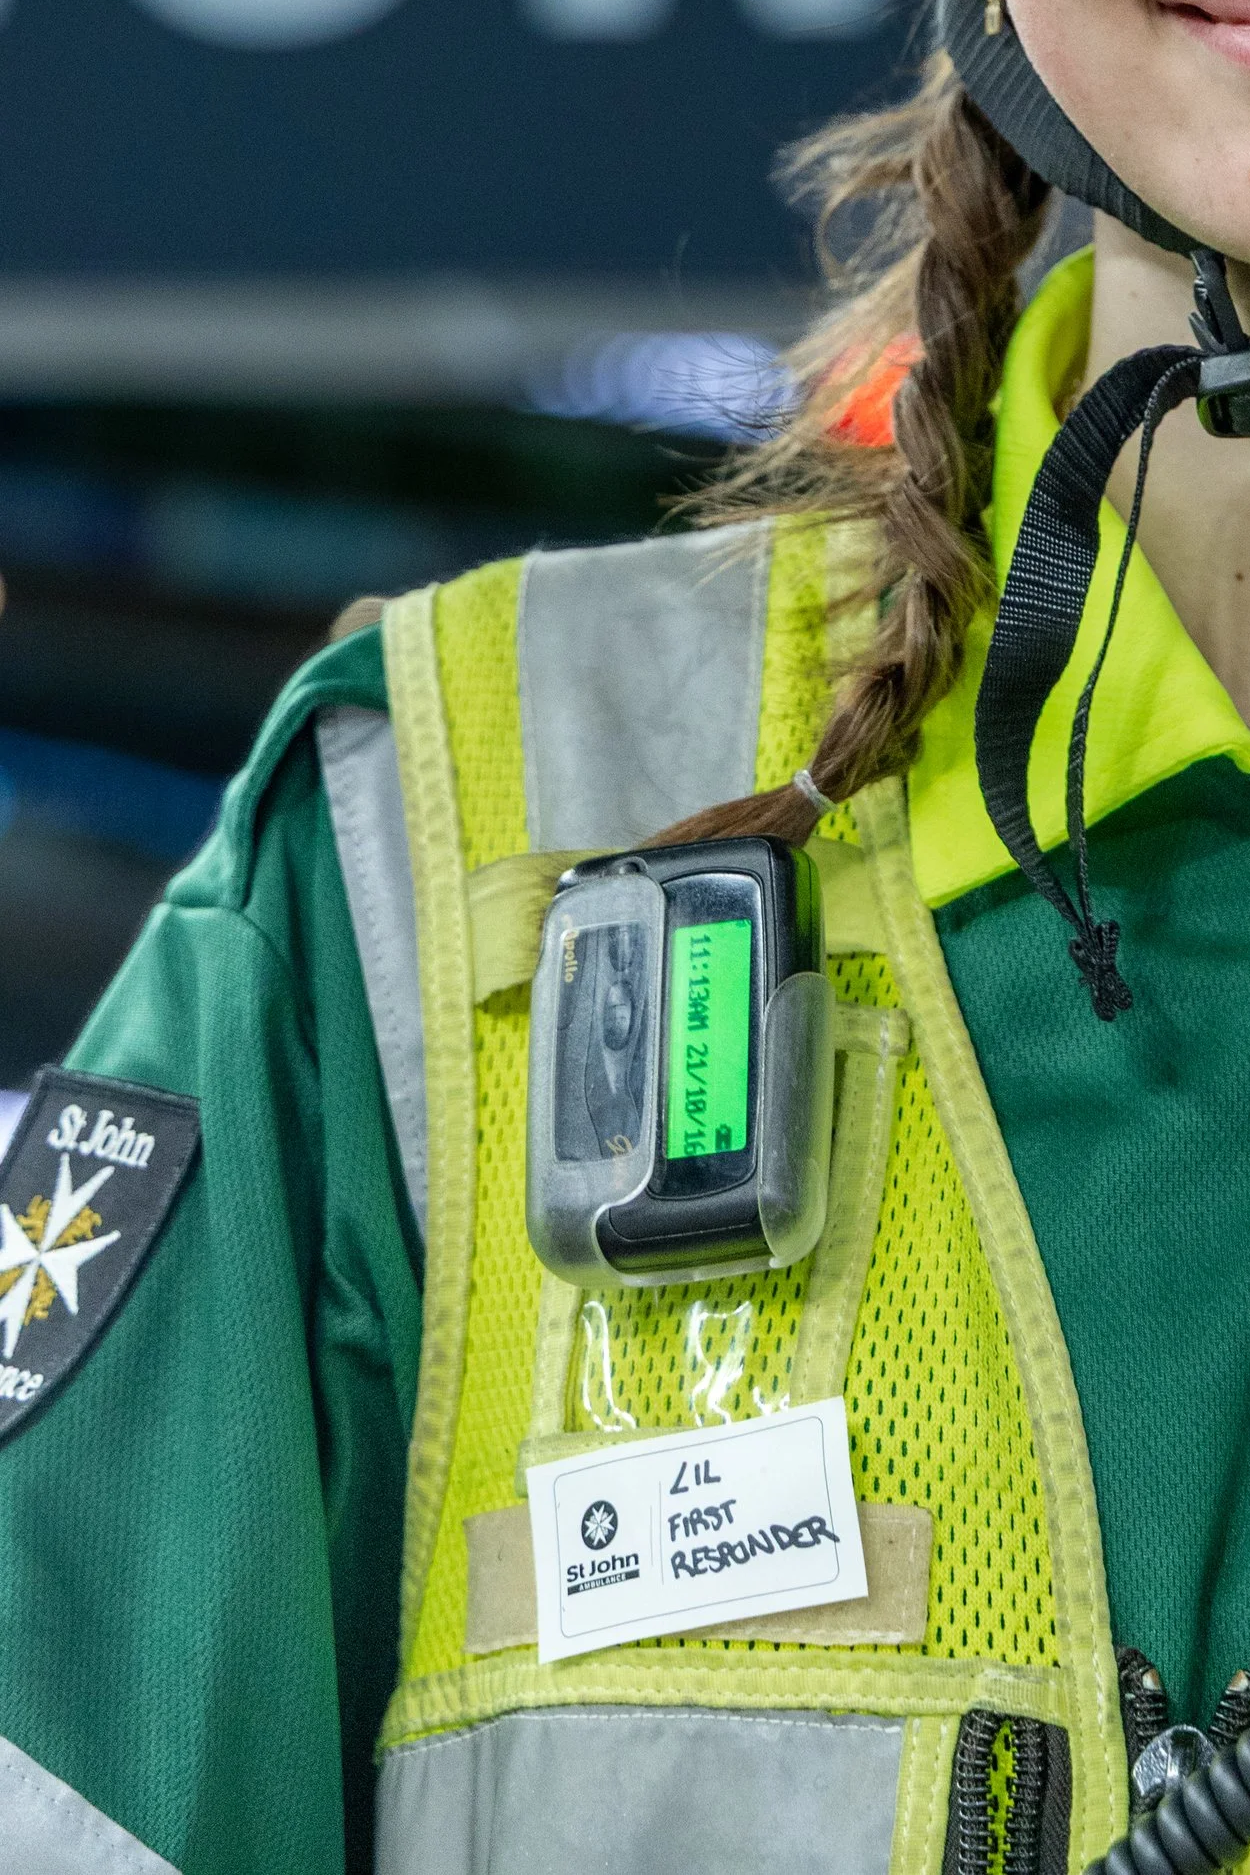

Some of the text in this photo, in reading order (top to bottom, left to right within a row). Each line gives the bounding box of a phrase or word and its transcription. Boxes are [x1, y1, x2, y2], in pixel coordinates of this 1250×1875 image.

[563, 928, 581, 984] Apollo
[687, 933, 712, 1032] 11:13AM
[0, 1363, 44, 1402] nce
[669, 1459, 722, 1495] LIL
[667, 1499, 737, 1542] FIRST
[566, 1553, 640, 1583] St John
[670, 1516, 841, 1579] RESPONDER
[577, 1572, 628, 1592] AMBULANCE
